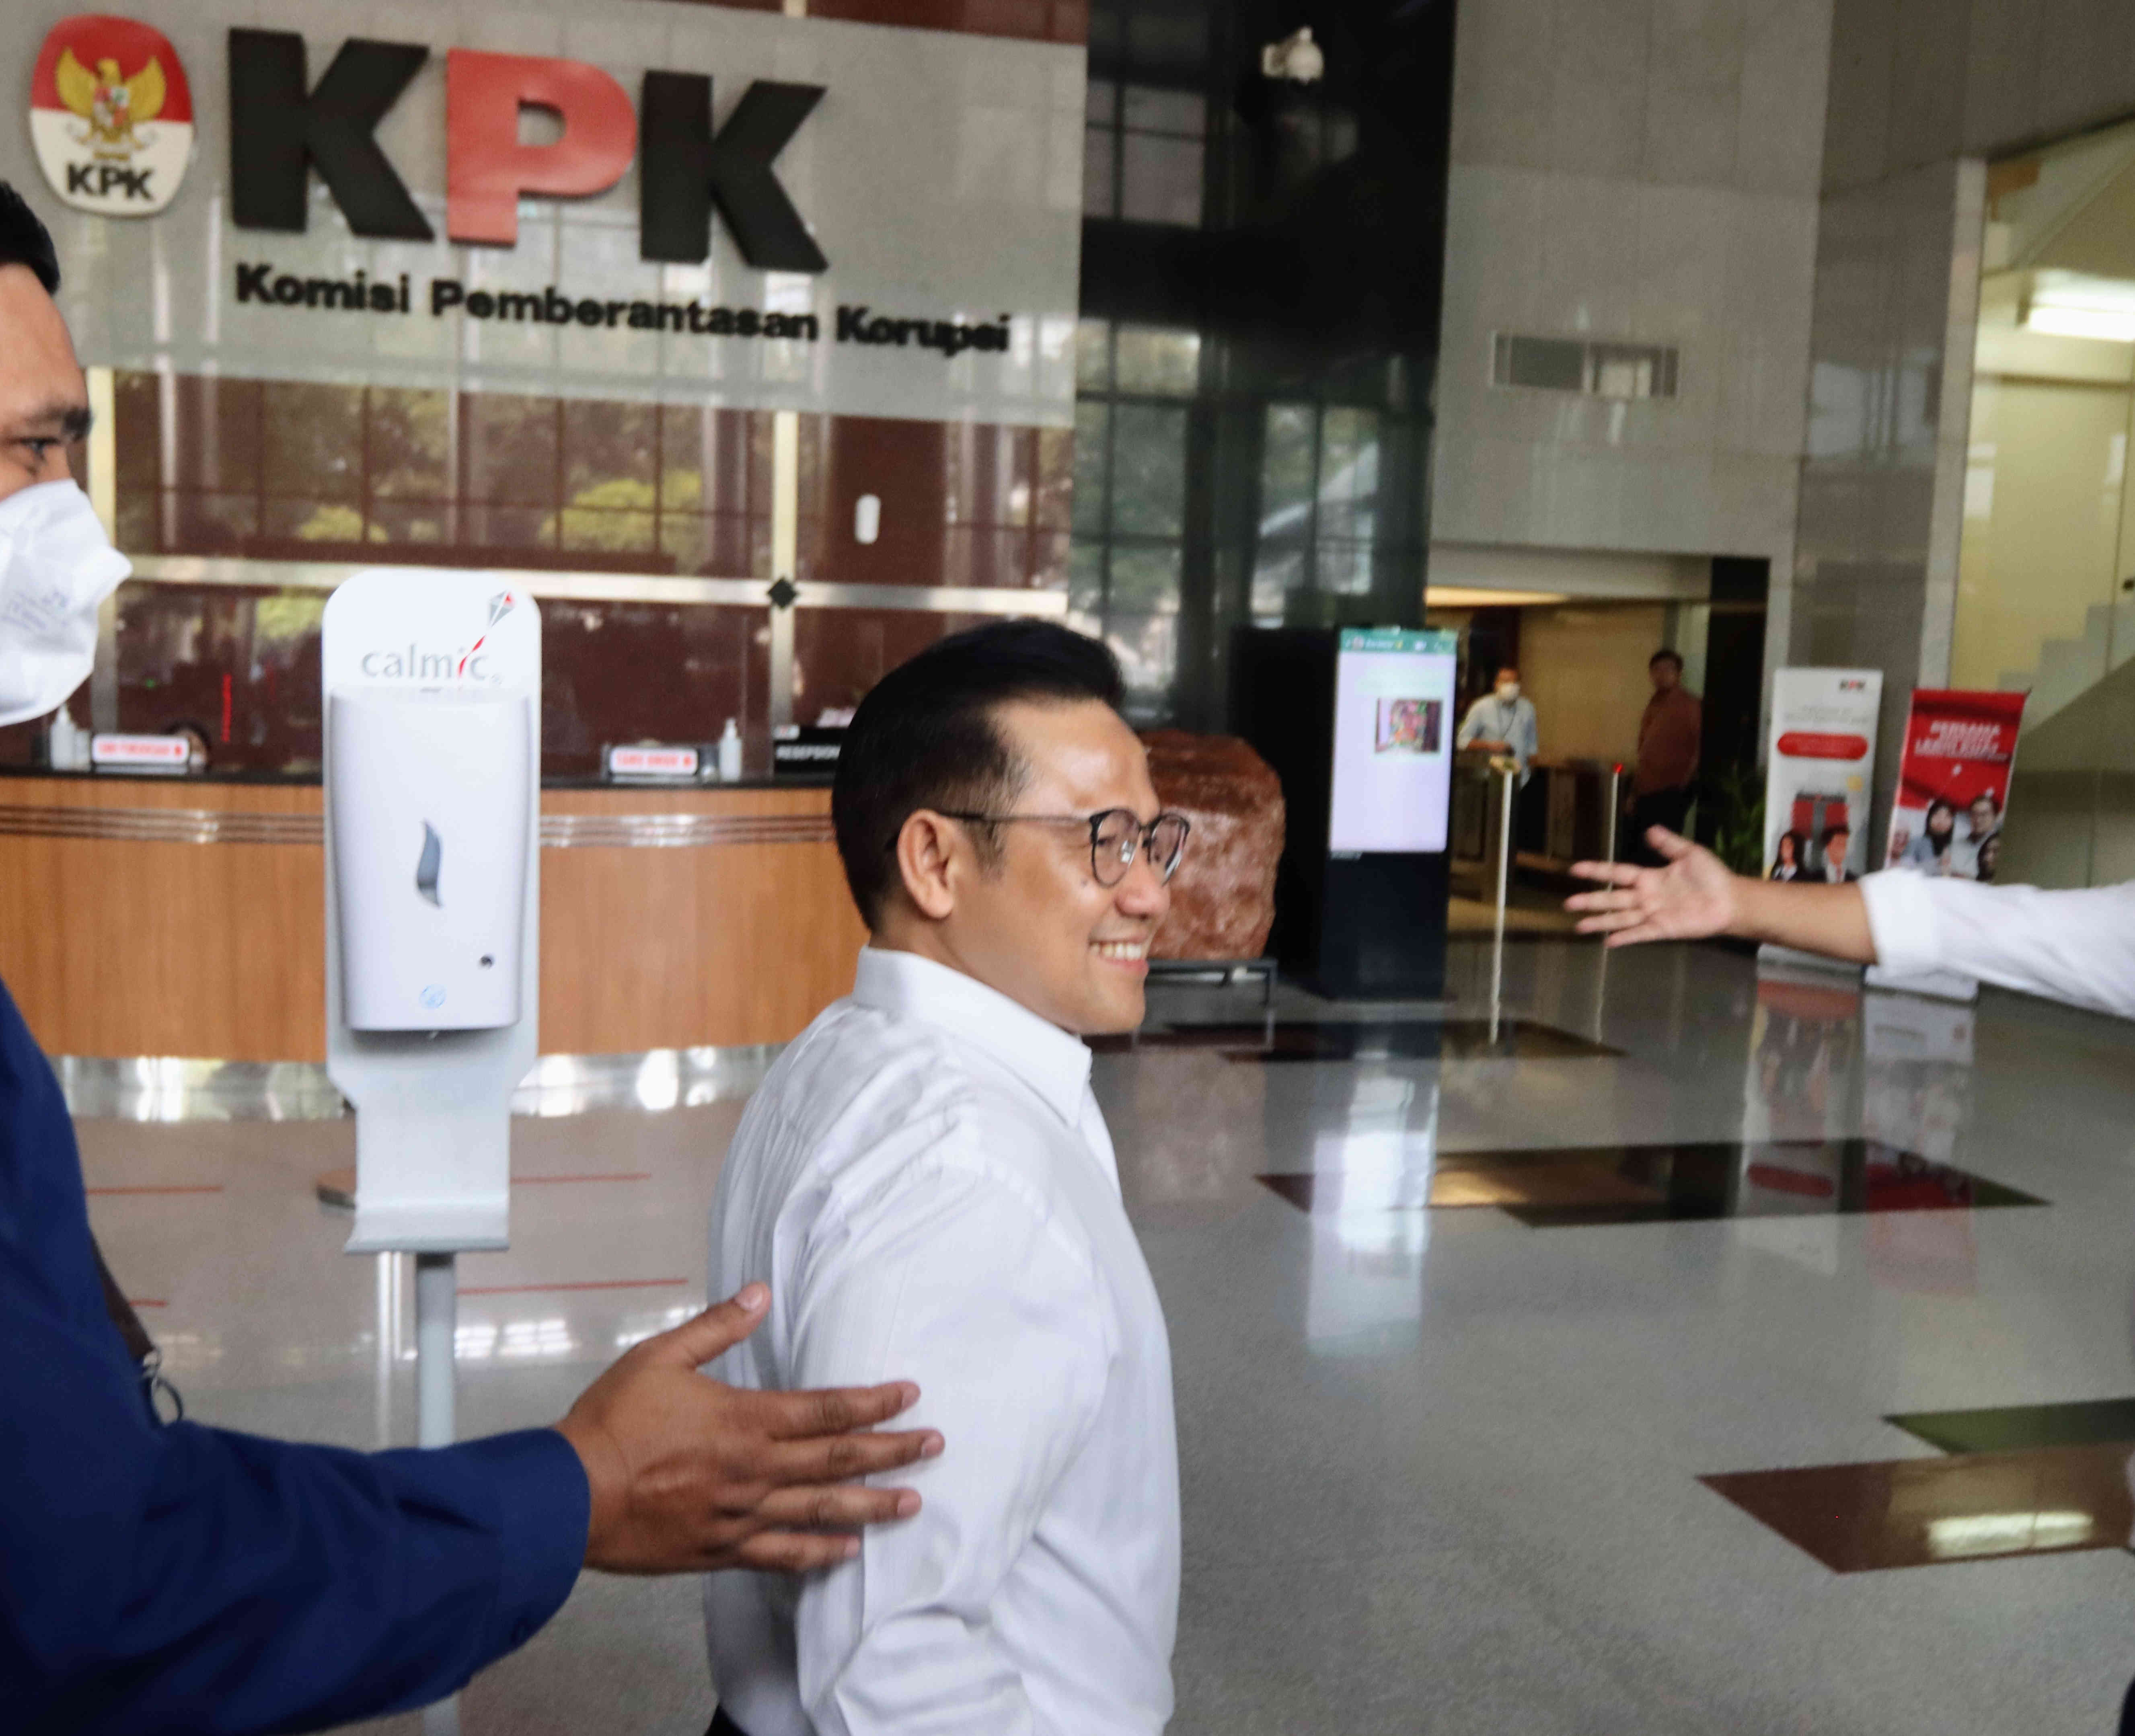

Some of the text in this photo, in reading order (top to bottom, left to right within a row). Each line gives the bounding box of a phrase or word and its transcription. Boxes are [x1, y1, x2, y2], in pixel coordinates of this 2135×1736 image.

[67, 162, 154, 201] KPK
[228, 27, 829, 273] KPK
[235, 261, 1010, 358] Komisi Pemberantasan Korupsi
[360, 634, 488, 682] calmic
